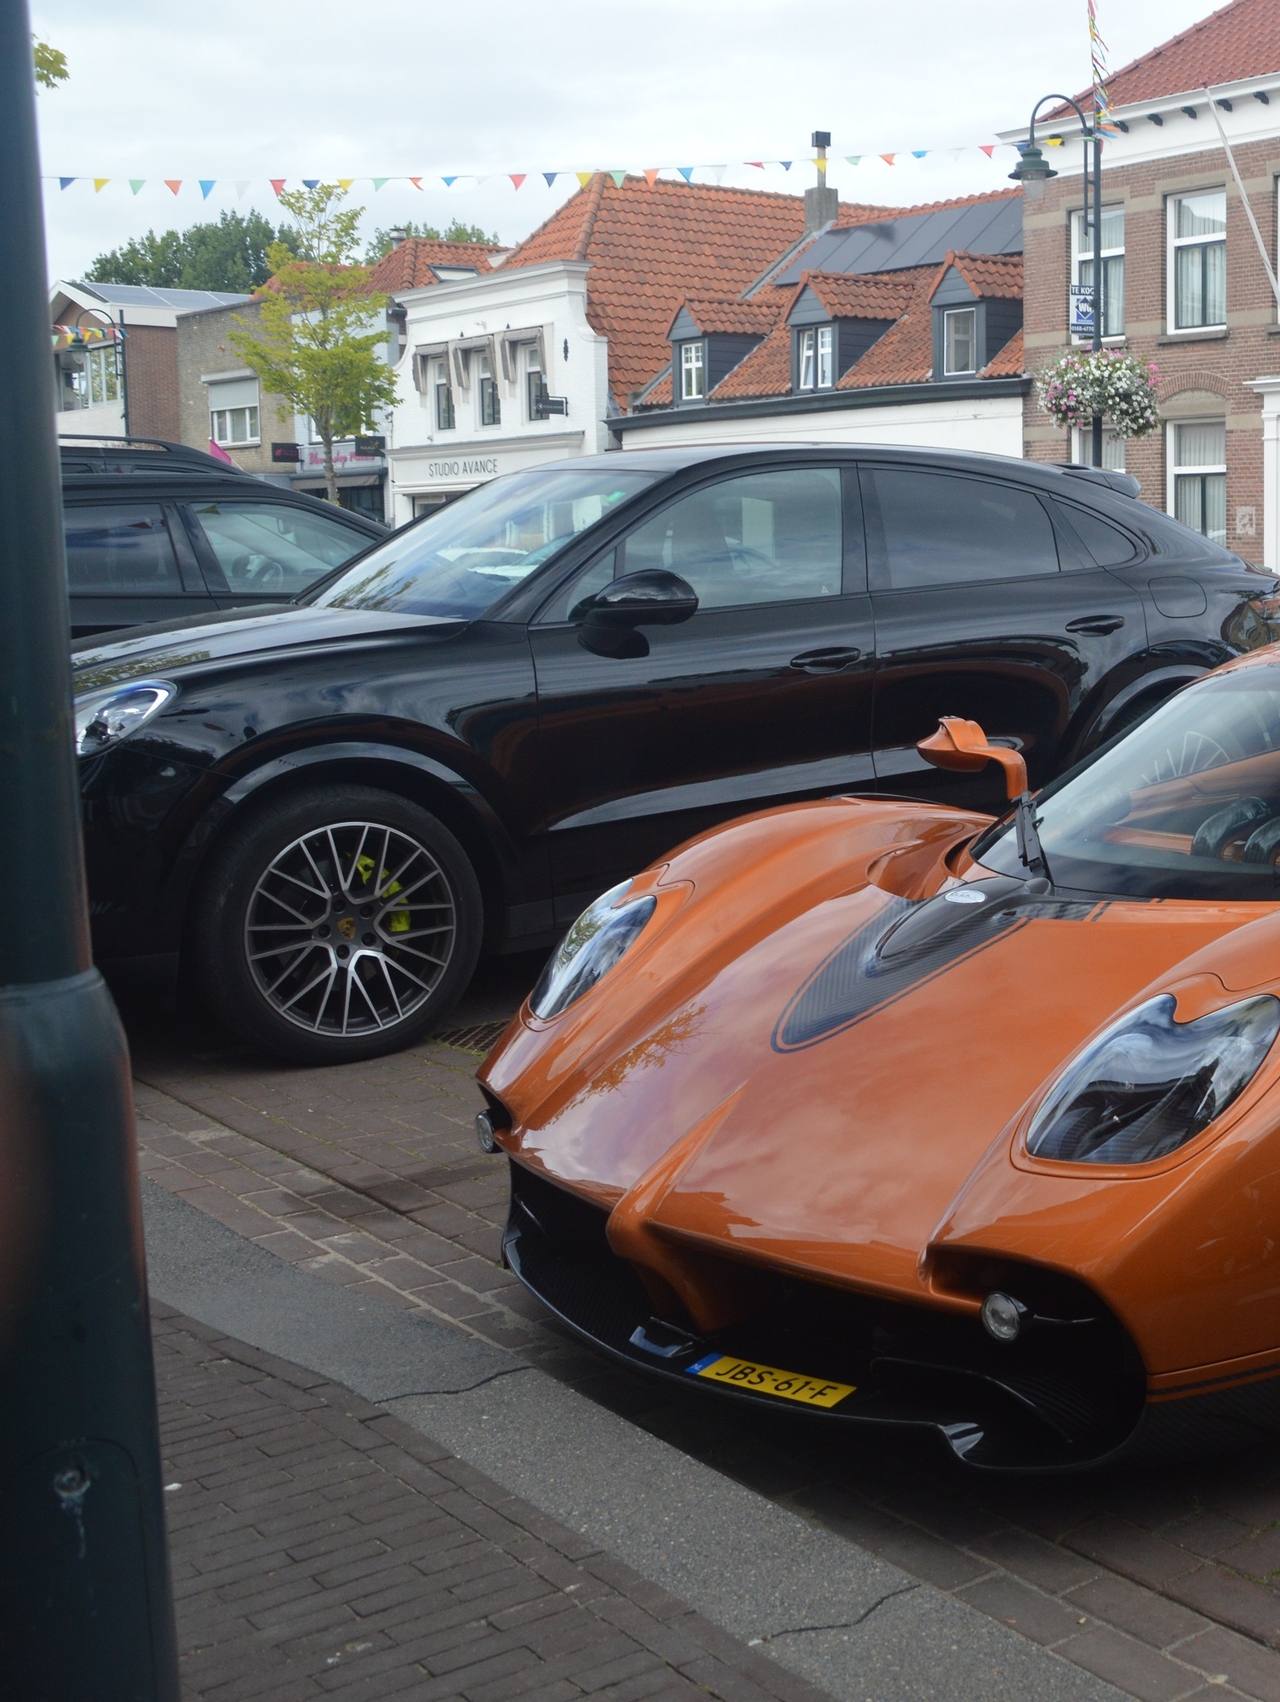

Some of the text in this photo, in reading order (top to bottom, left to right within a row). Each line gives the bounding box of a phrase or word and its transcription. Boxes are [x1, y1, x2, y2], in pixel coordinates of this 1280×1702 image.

[1071, 286, 1080, 295] TE
[429, 459, 498, 477] STUDIO AVANCE
[715, 1363, 838, 1400] JBS-61-F
